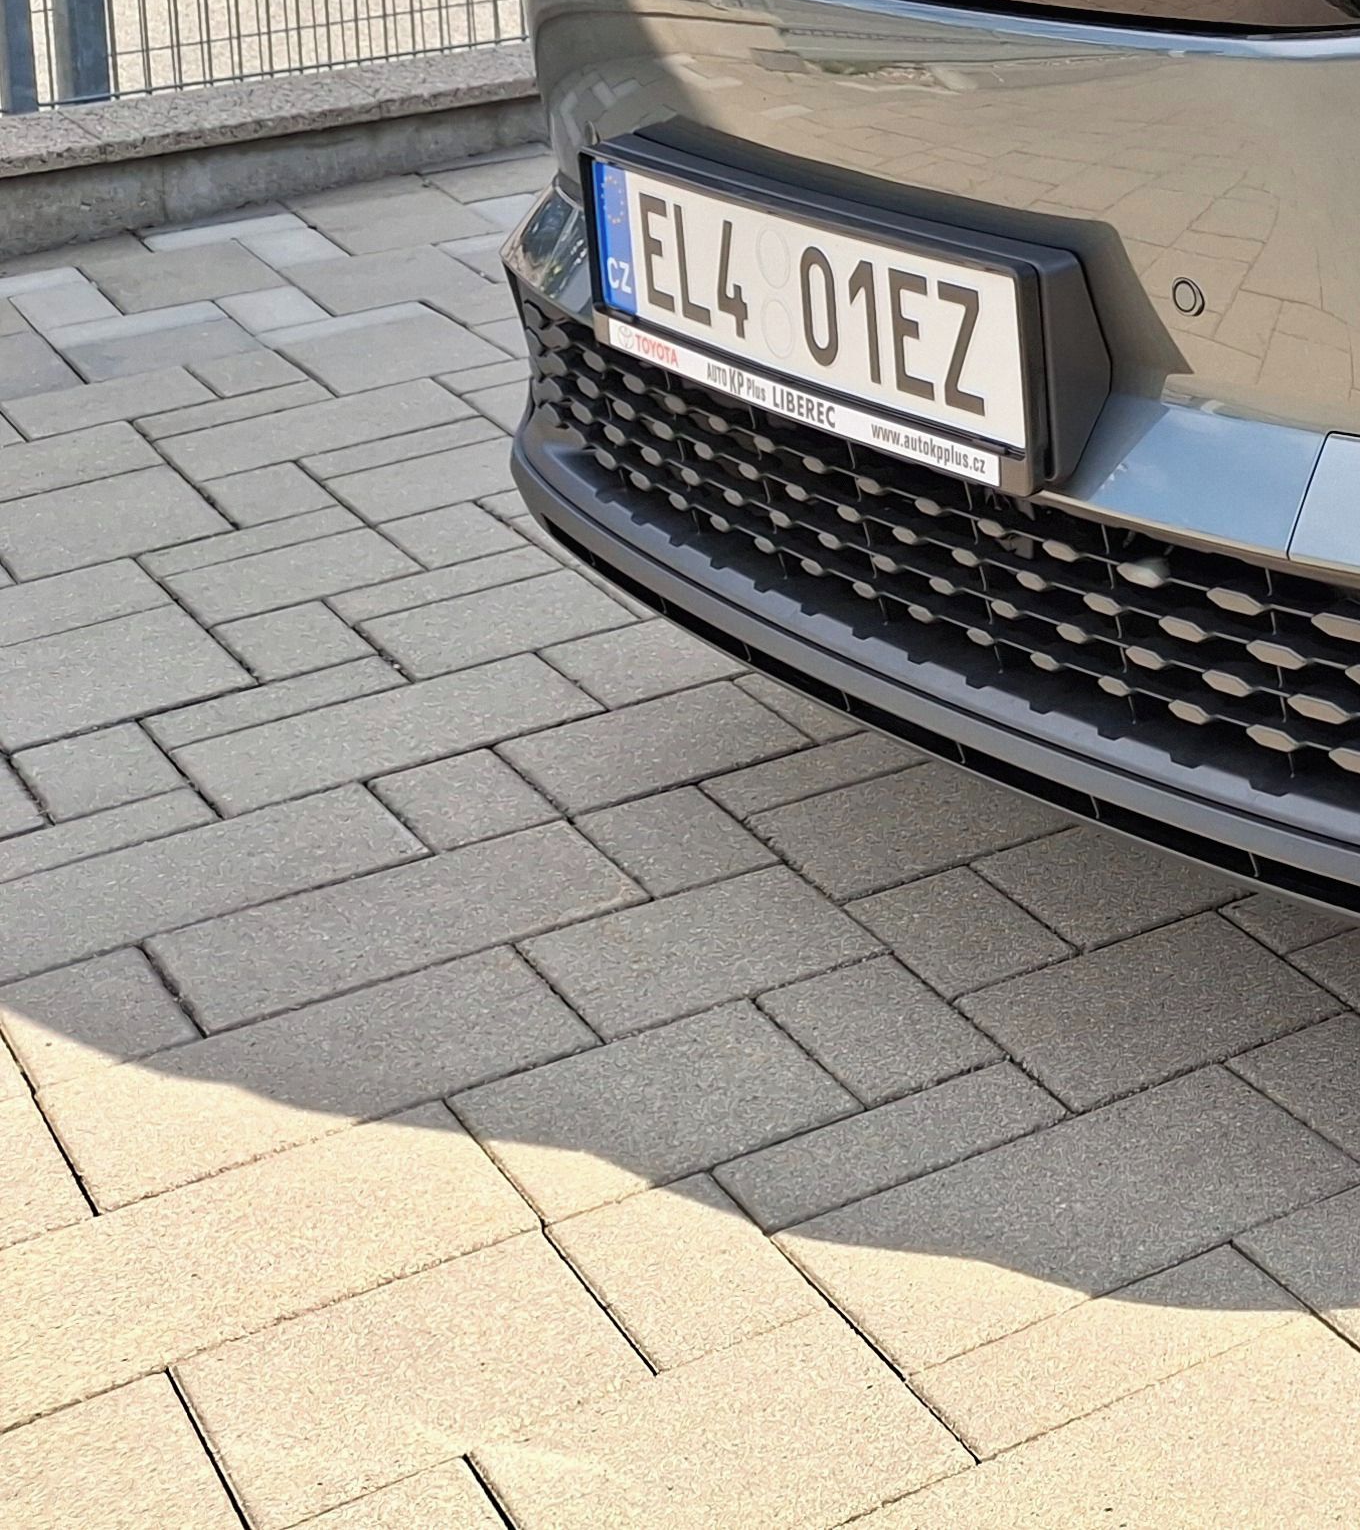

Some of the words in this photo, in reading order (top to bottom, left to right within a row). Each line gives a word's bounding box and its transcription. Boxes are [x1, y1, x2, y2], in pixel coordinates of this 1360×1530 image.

[607, 256, 633, 295] CZ
[639, 192, 749, 340] EL4
[800, 246, 985, 417] 01EZ
[635, 335, 680, 368] TOYOTA
[707, 362, 728, 388] AUTO
[729, 368, 745, 395] KP
[747, 381, 767, 402] Plus
[772, 386, 836, 429] LIBEREC
[871, 423, 987, 475] www.autokpplus.cz
